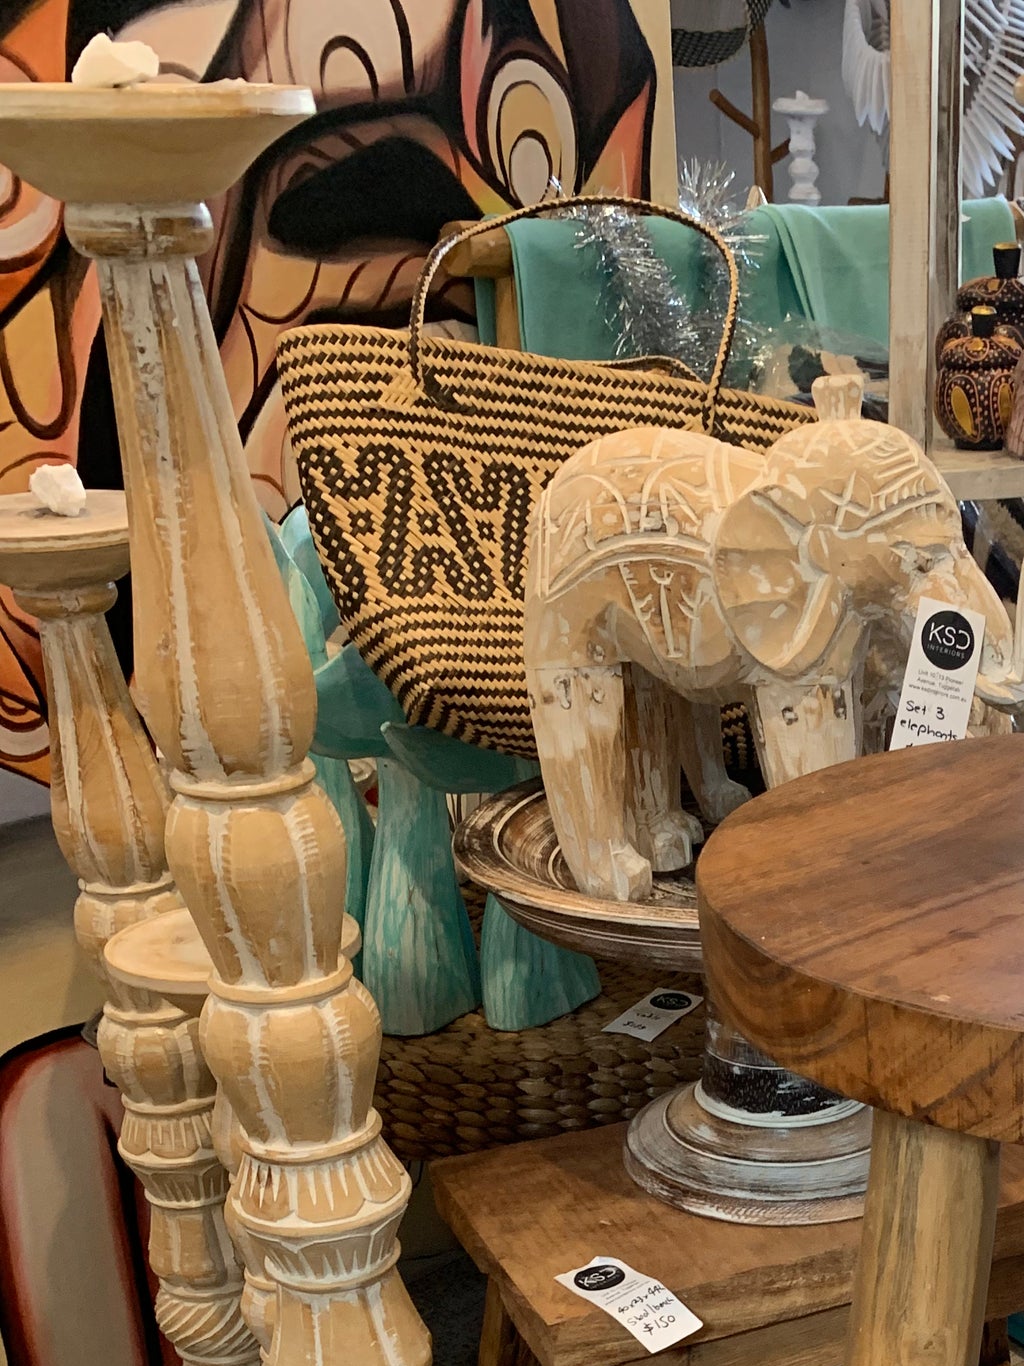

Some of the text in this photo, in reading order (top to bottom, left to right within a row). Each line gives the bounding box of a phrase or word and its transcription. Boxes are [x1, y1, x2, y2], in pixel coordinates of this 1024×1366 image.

[927, 643, 966, 660] INTERIORS
[905, 700, 945, 720] Set 3
[900, 718, 958, 741] elephants
[643, 1314, 676, 1336] $150
